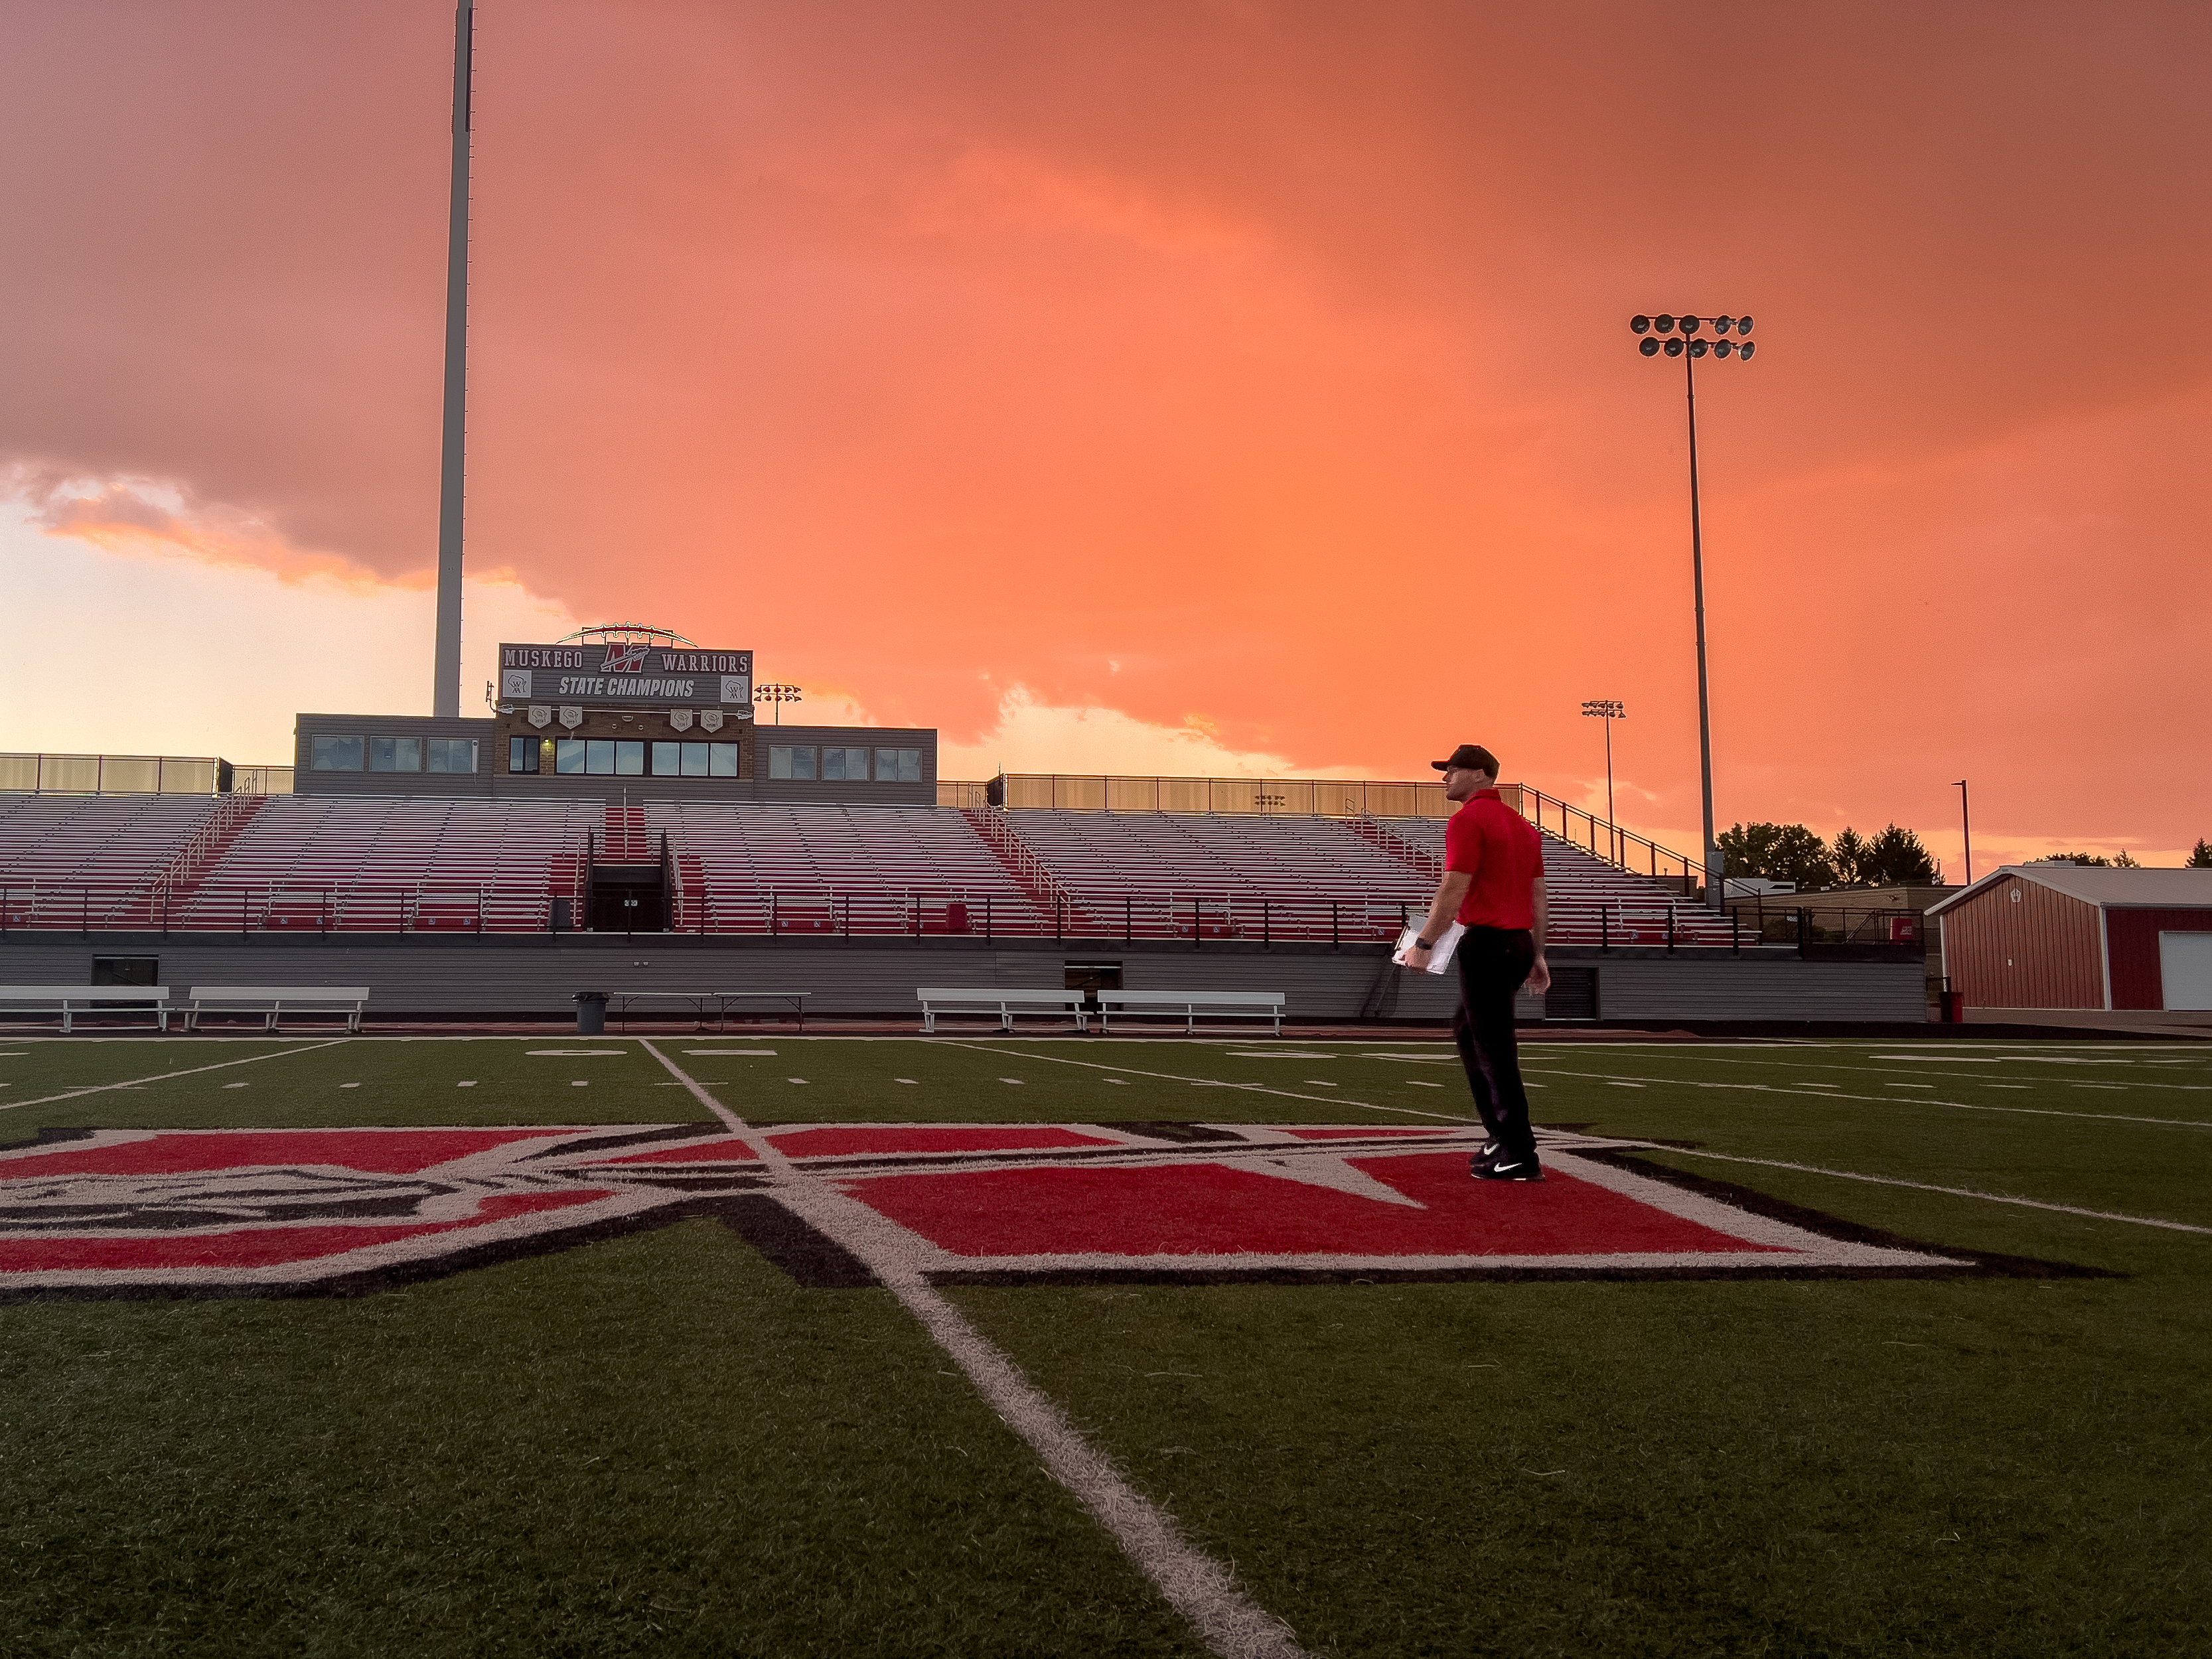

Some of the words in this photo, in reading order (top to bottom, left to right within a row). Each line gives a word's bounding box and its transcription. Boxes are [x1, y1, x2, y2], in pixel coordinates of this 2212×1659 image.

[504, 650, 582, 668] MUSKEGO
[662, 654, 747, 672] WARRIORS
[559, 677, 605, 695] STATE
[607, 678, 694, 697] CHAMPIONS
